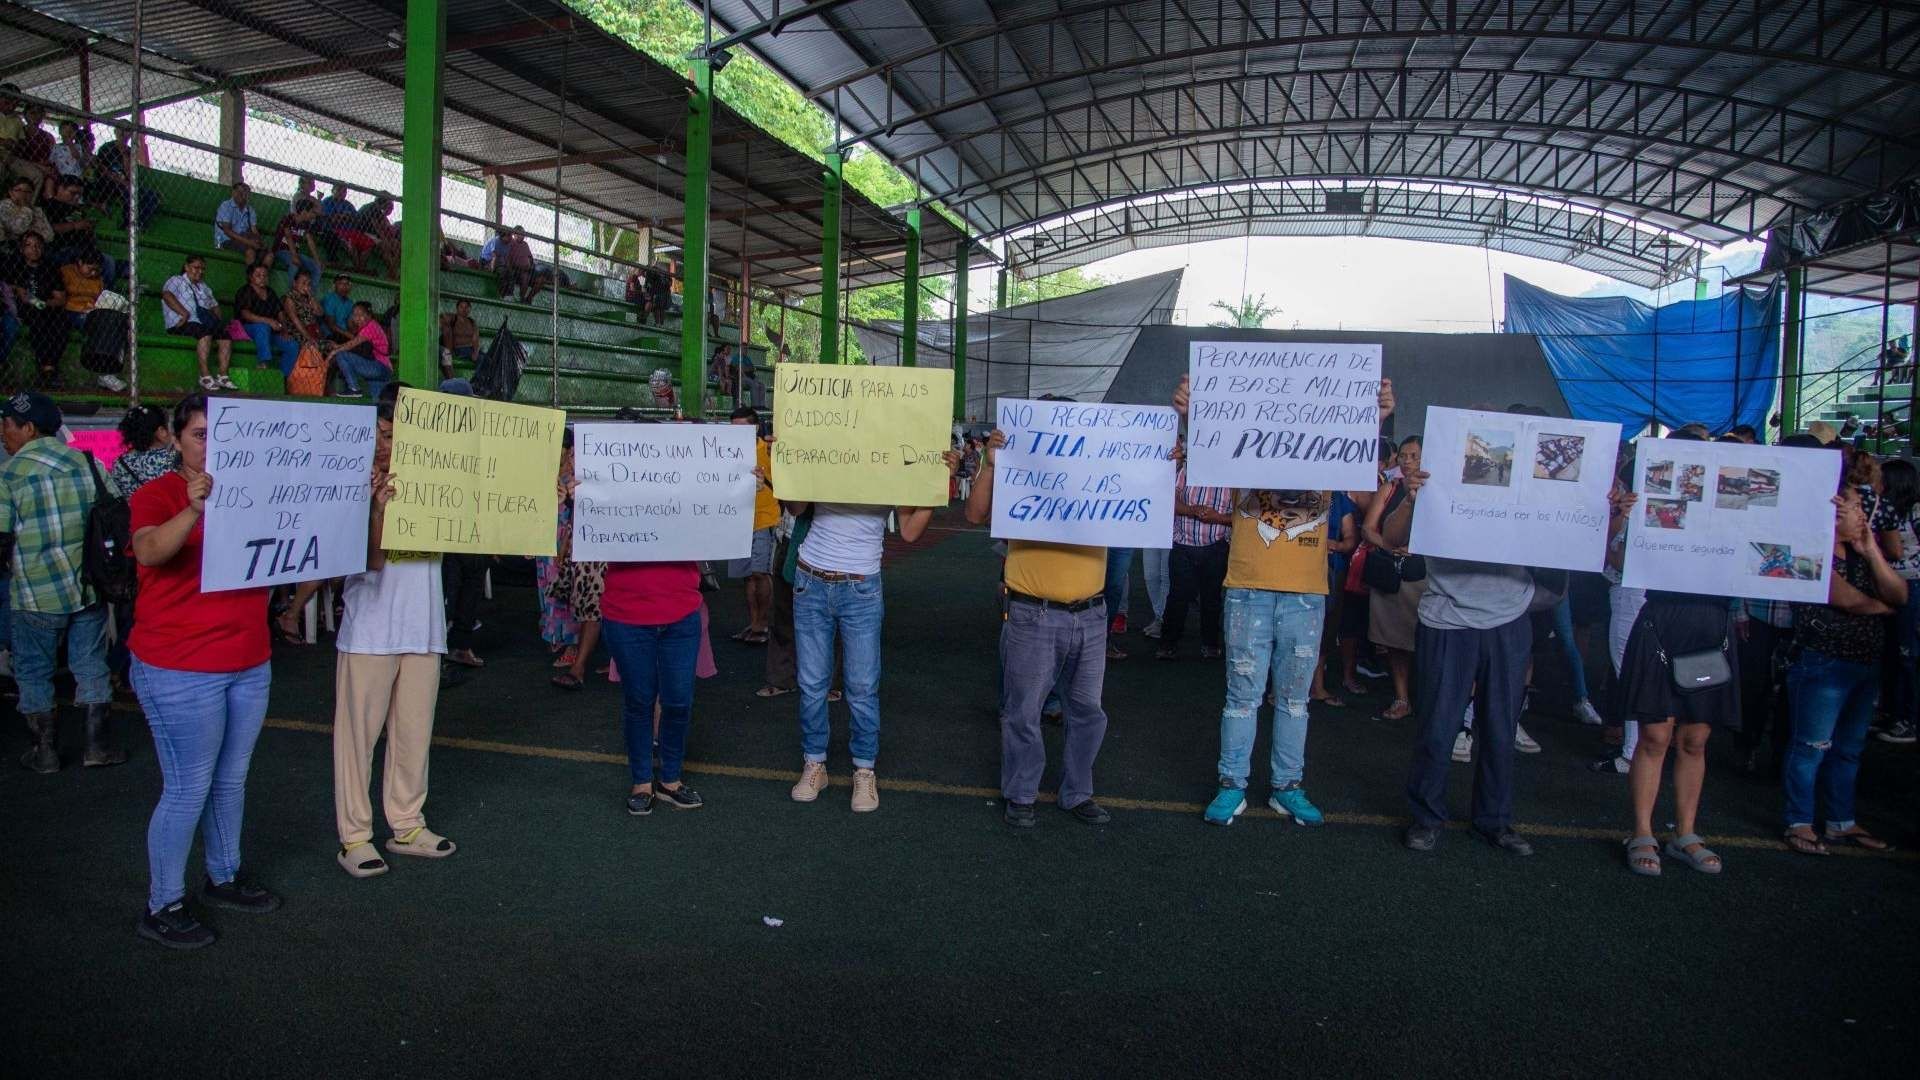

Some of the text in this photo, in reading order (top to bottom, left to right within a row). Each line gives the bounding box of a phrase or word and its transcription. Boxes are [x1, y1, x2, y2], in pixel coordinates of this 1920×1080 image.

[1197, 345, 1373, 372] PERMANENCIA DE
[860, 378, 894, 398] PARA
[901, 383, 929, 398] LOS
[1192, 375, 1380, 399] LA BASE MILITAR
[213, 406, 374, 444] EXIGIMOS SEGURI-
[784, 407, 859, 429] CAIDOS!!
[1002, 404, 1176, 431] NO REGRESAMOS
[1193, 399, 1377, 425] PARA RESGUARDAR
[481, 411, 539, 440] EFECTIVA
[547, 422, 556, 443] Y
[395, 441, 481, 476] PERMANENTE
[665, 444, 693, 459] UNA
[702, 433, 744, 460] MESA
[871, 451, 889, 464] DE
[1003, 434, 1016, 450] A
[1098, 440, 1151, 461] HASTA
[1192, 428, 1377, 463] LA POBLACION
[214, 446, 366, 473] DAD PARA TODOS
[583, 467, 600, 481] DE
[696, 471, 720, 484] CON
[728, 471, 741, 483] LA
[1001, 466, 1122, 495] TENER LAS
[214, 483, 369, 509] LOS HABITANTES
[391, 478, 538, 514] DENTRO Y FUERA
[693, 503, 710, 516] DE
[718, 503, 737, 516] LOS
[1008, 495, 1151, 522] GARANTIAS
[275, 511, 304, 530] DE
[398, 516, 480, 543] DE TILA
[1514, 511, 1529, 521] por
[1537, 510, 1550, 522] los
[578, 523, 659, 544] POBLADORES
[244, 535, 319, 582] TILA
